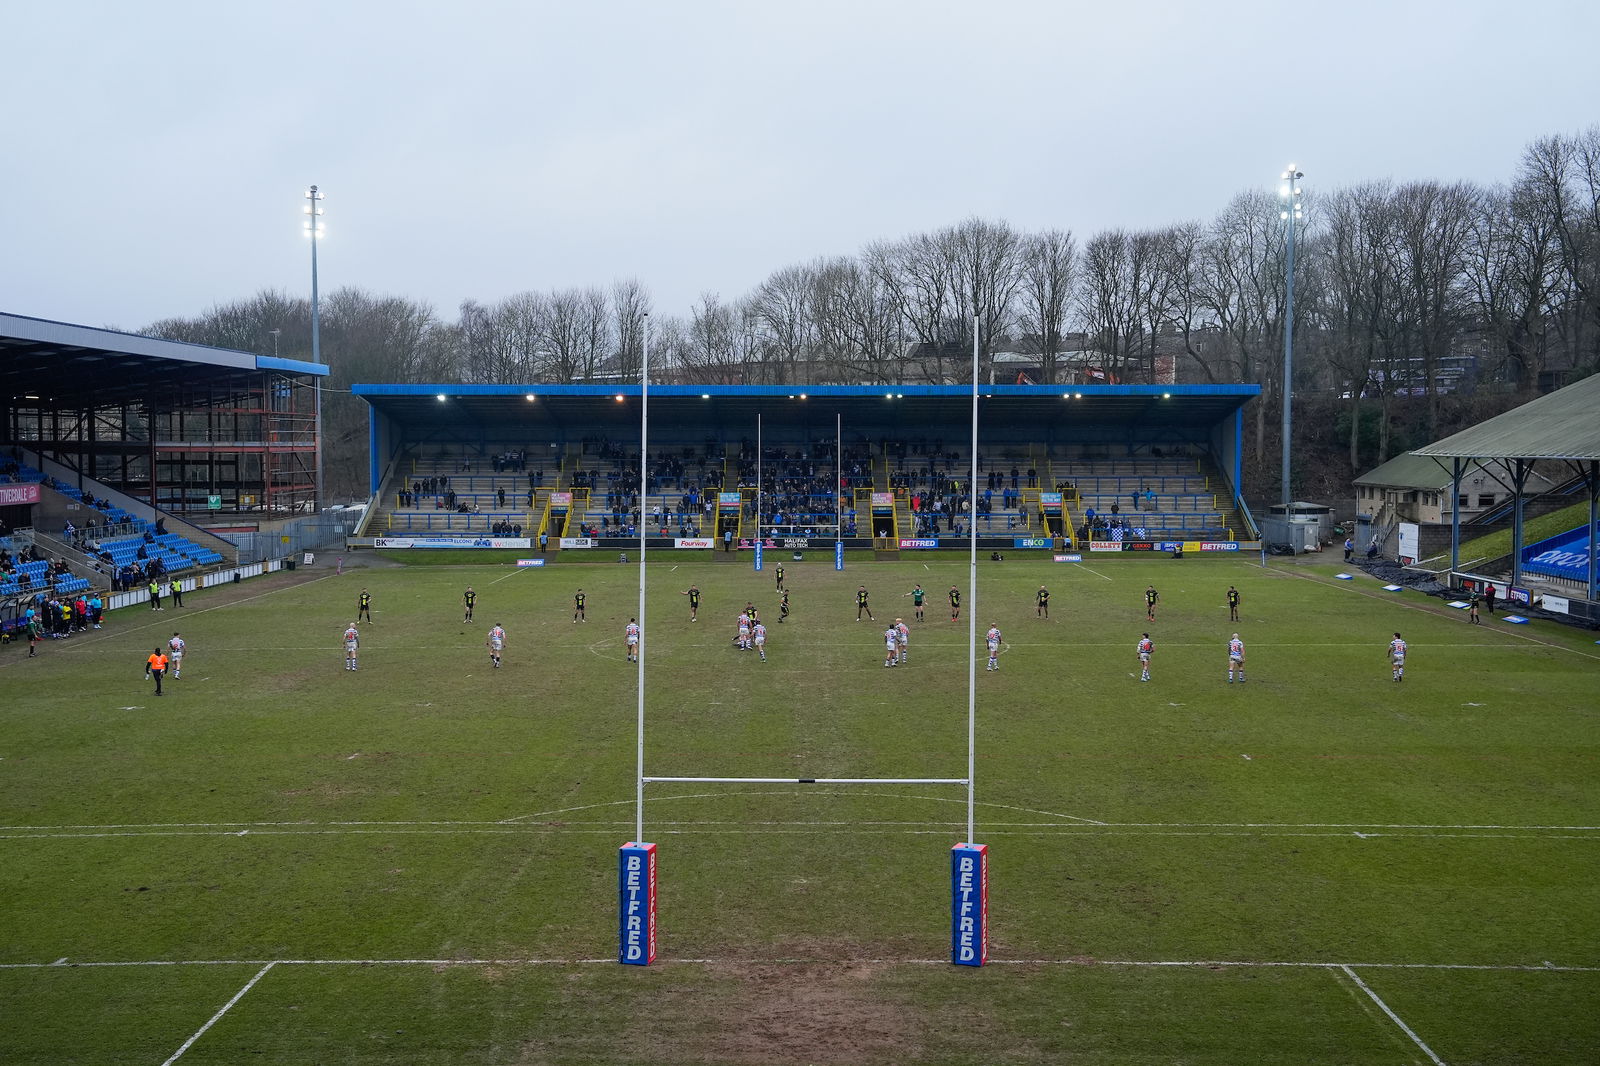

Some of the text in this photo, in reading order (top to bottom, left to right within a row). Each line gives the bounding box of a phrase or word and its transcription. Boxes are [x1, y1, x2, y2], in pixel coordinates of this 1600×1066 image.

[376, 539, 387, 547] BK
[901, 539, 936, 547] BETFRED
[627, 856, 642, 960] BETFRED
[960, 857, 975, 961] BETFRED
